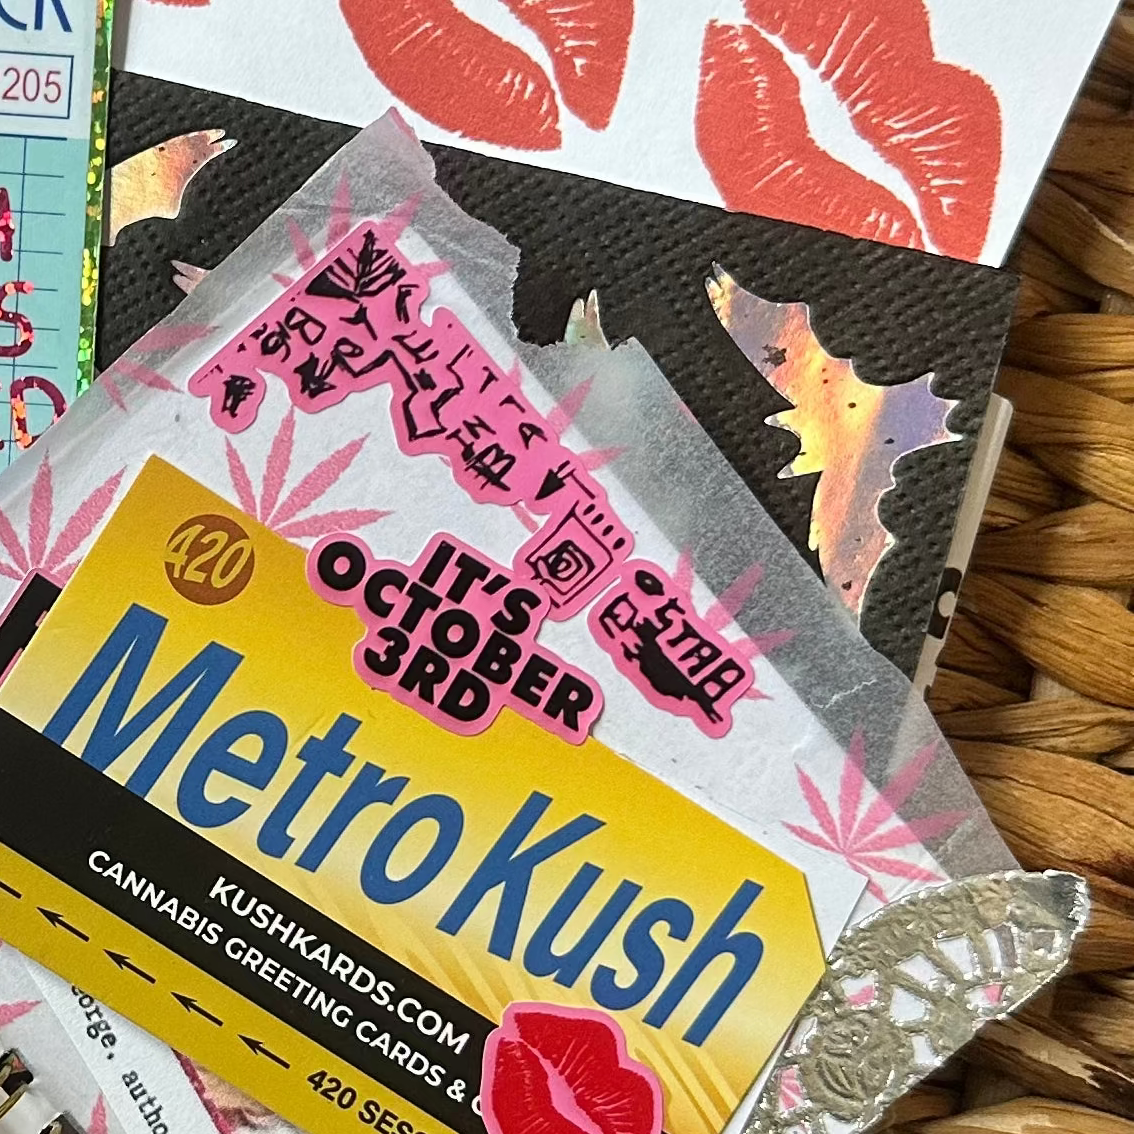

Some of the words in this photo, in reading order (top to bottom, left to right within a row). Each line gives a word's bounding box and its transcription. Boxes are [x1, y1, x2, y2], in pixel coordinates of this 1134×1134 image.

[165, 522, 254, 588] 420
[418, 540, 542, 636] IT'S
[317, 540, 594, 731] OCTOBER
[363, 627, 491, 719] 3RD
[88, 850, 223, 946] CANNABIS
[224, 937, 350, 1028] GREETING
[355, 1017, 446, 1087] CARDS
[446, 1079, 466, 1102] &
[209, 876, 470, 1056] KUSHKARDS.COM
[307, 1070, 358, 1112] 420
